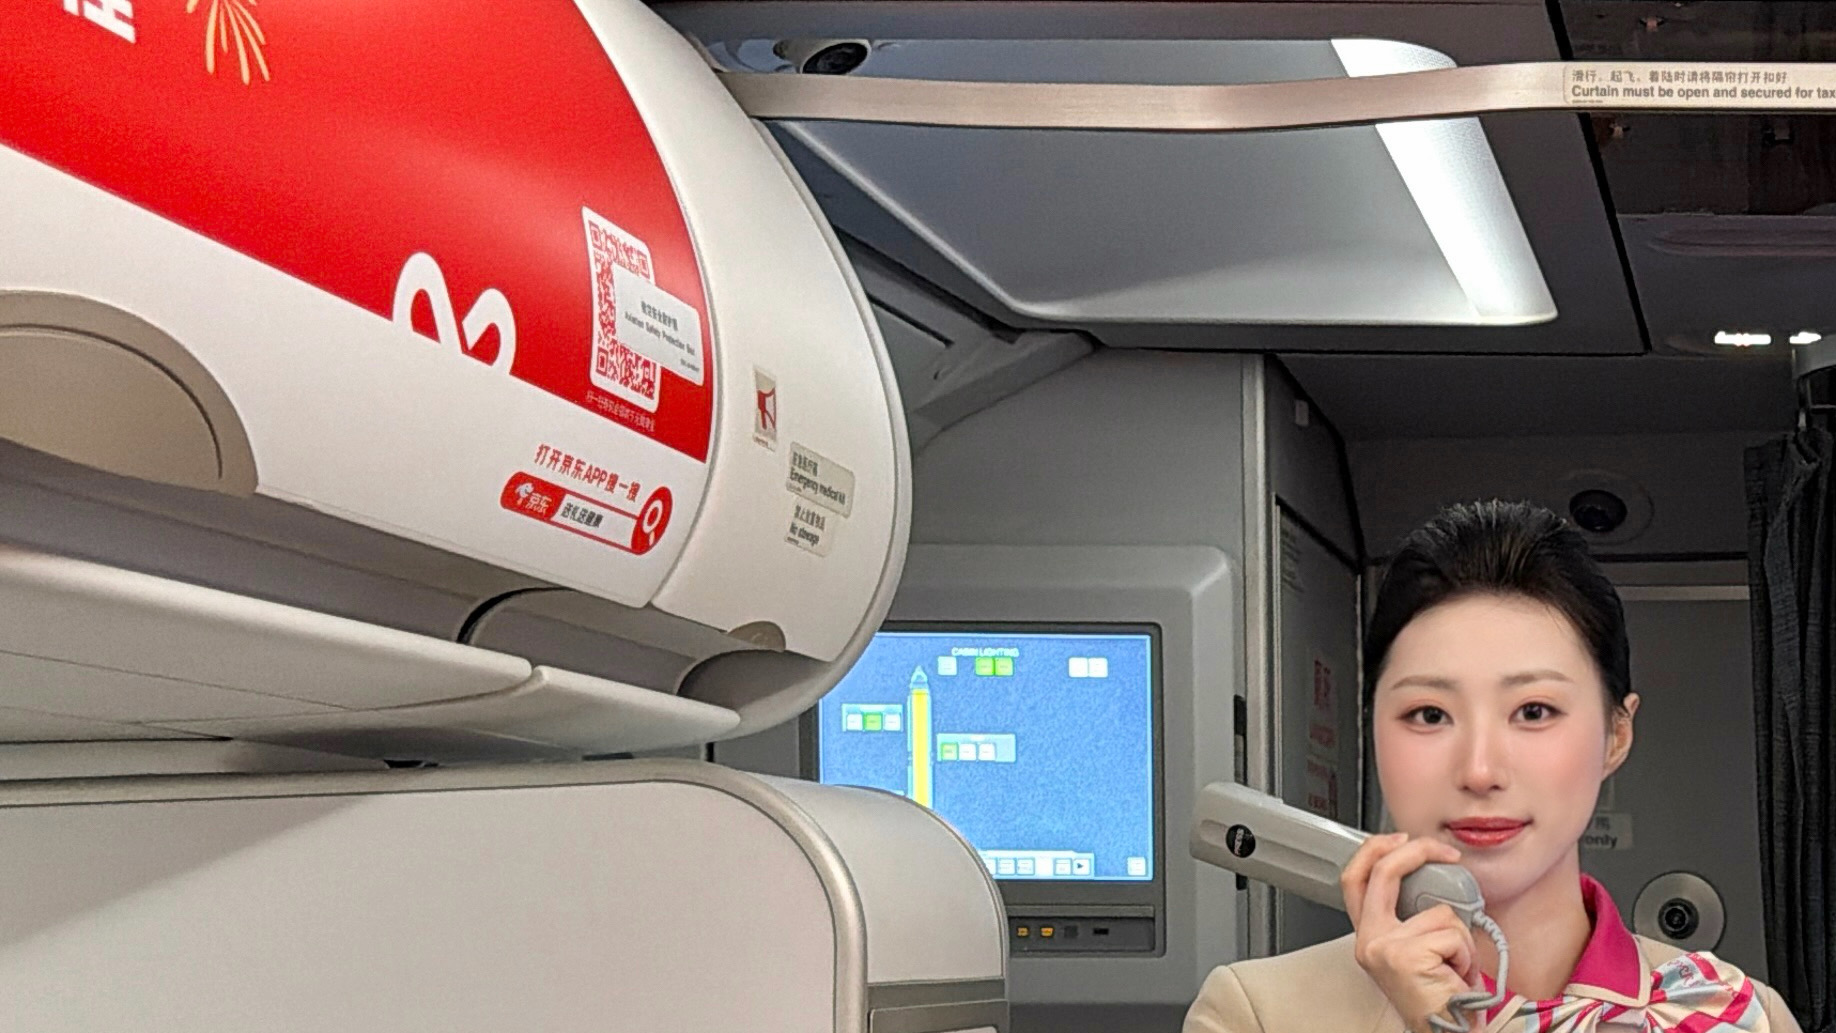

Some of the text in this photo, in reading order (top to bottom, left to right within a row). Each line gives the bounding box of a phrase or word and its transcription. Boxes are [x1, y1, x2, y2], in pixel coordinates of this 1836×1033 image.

[1572, 85, 1619, 98] Curtain
[1623, 86, 1654, 98] must
[1658, 85, 1673, 98] be
[1681, 87, 1709, 101] open
[1713, 86, 1737, 98] and
[1741, 86, 1792, 98] secured
[1795, 86, 1812, 99] for
[533, 443, 641, 503] 打开京东APP搜一搜
[790, 467, 819, 494] Emergency
[525, 492, 552, 516] 京东
[979, 648, 1020, 657] LIGHTING
[1585, 834, 1617, 849] only
